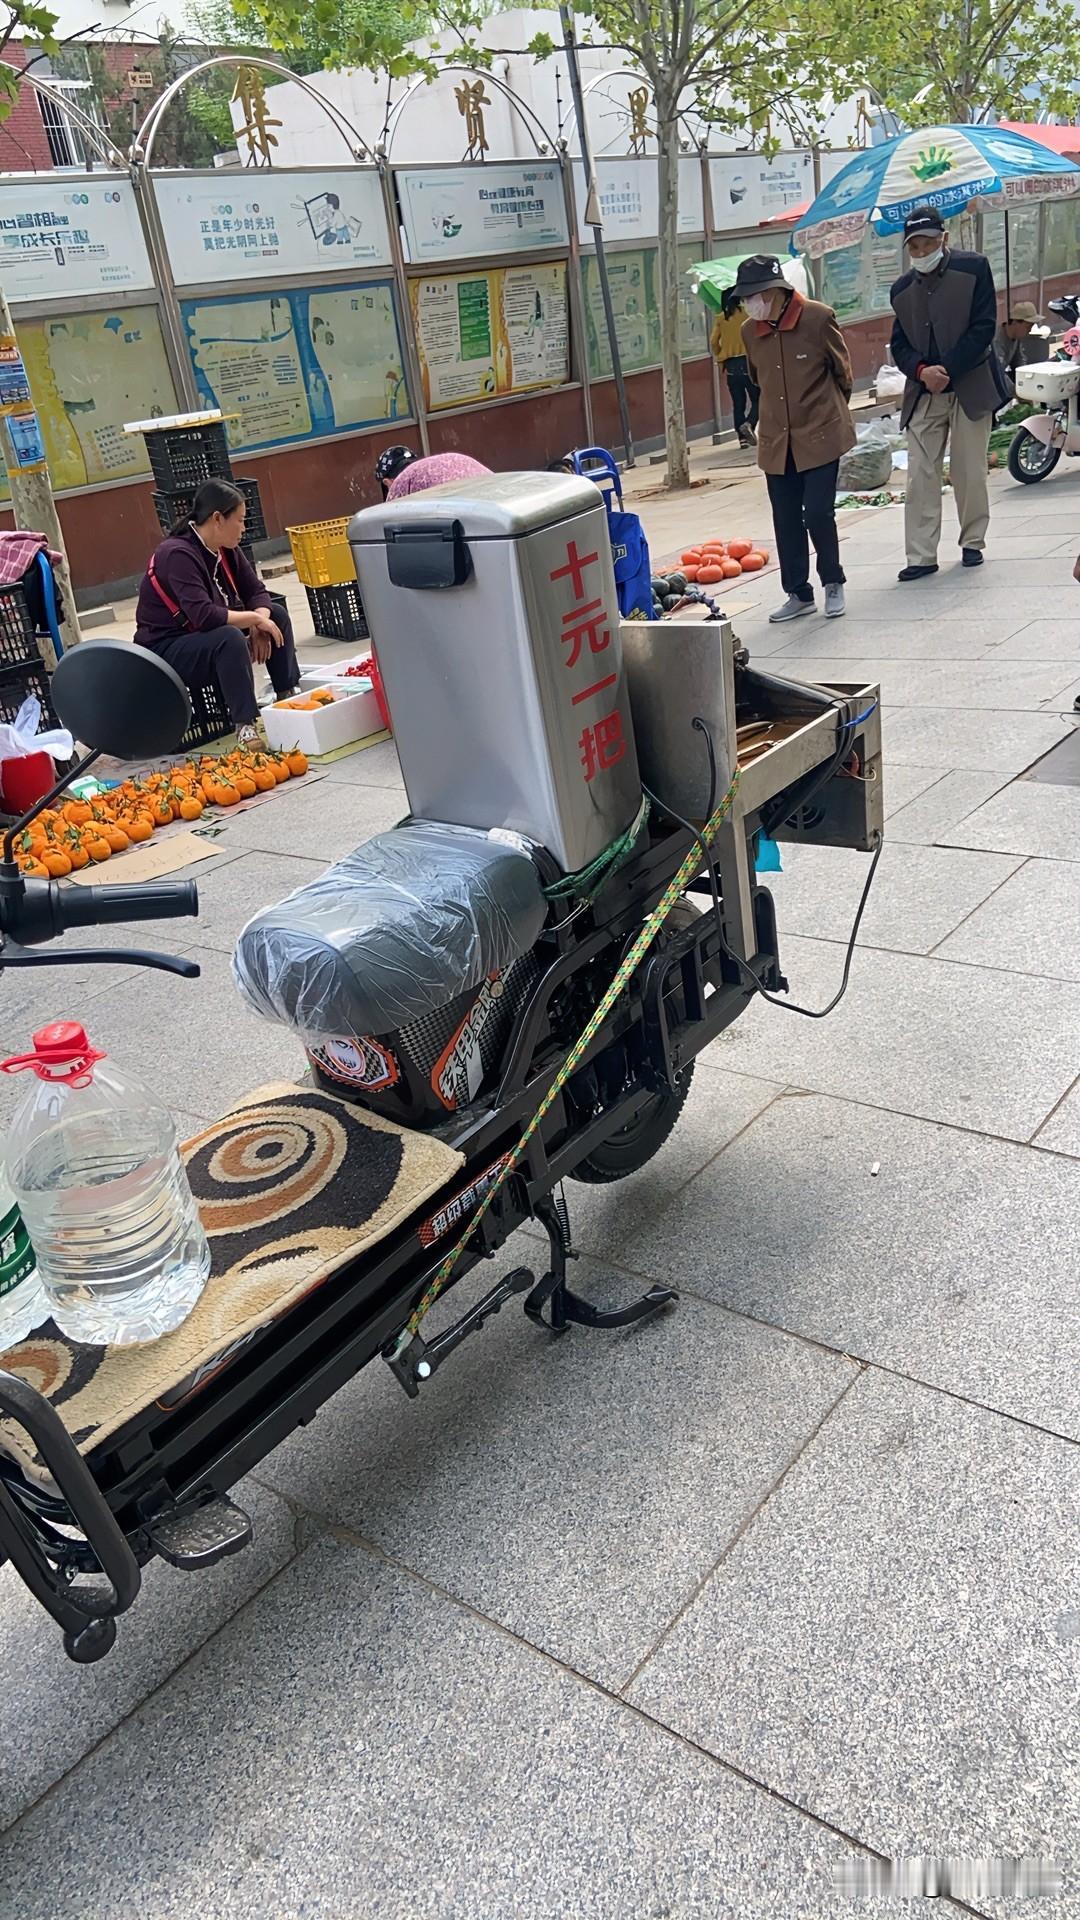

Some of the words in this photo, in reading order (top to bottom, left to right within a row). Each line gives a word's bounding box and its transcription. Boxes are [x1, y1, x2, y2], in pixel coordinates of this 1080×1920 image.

[200, 217, 275, 233] 正是年少时光好
[549, 540, 627, 782] 十元一把
